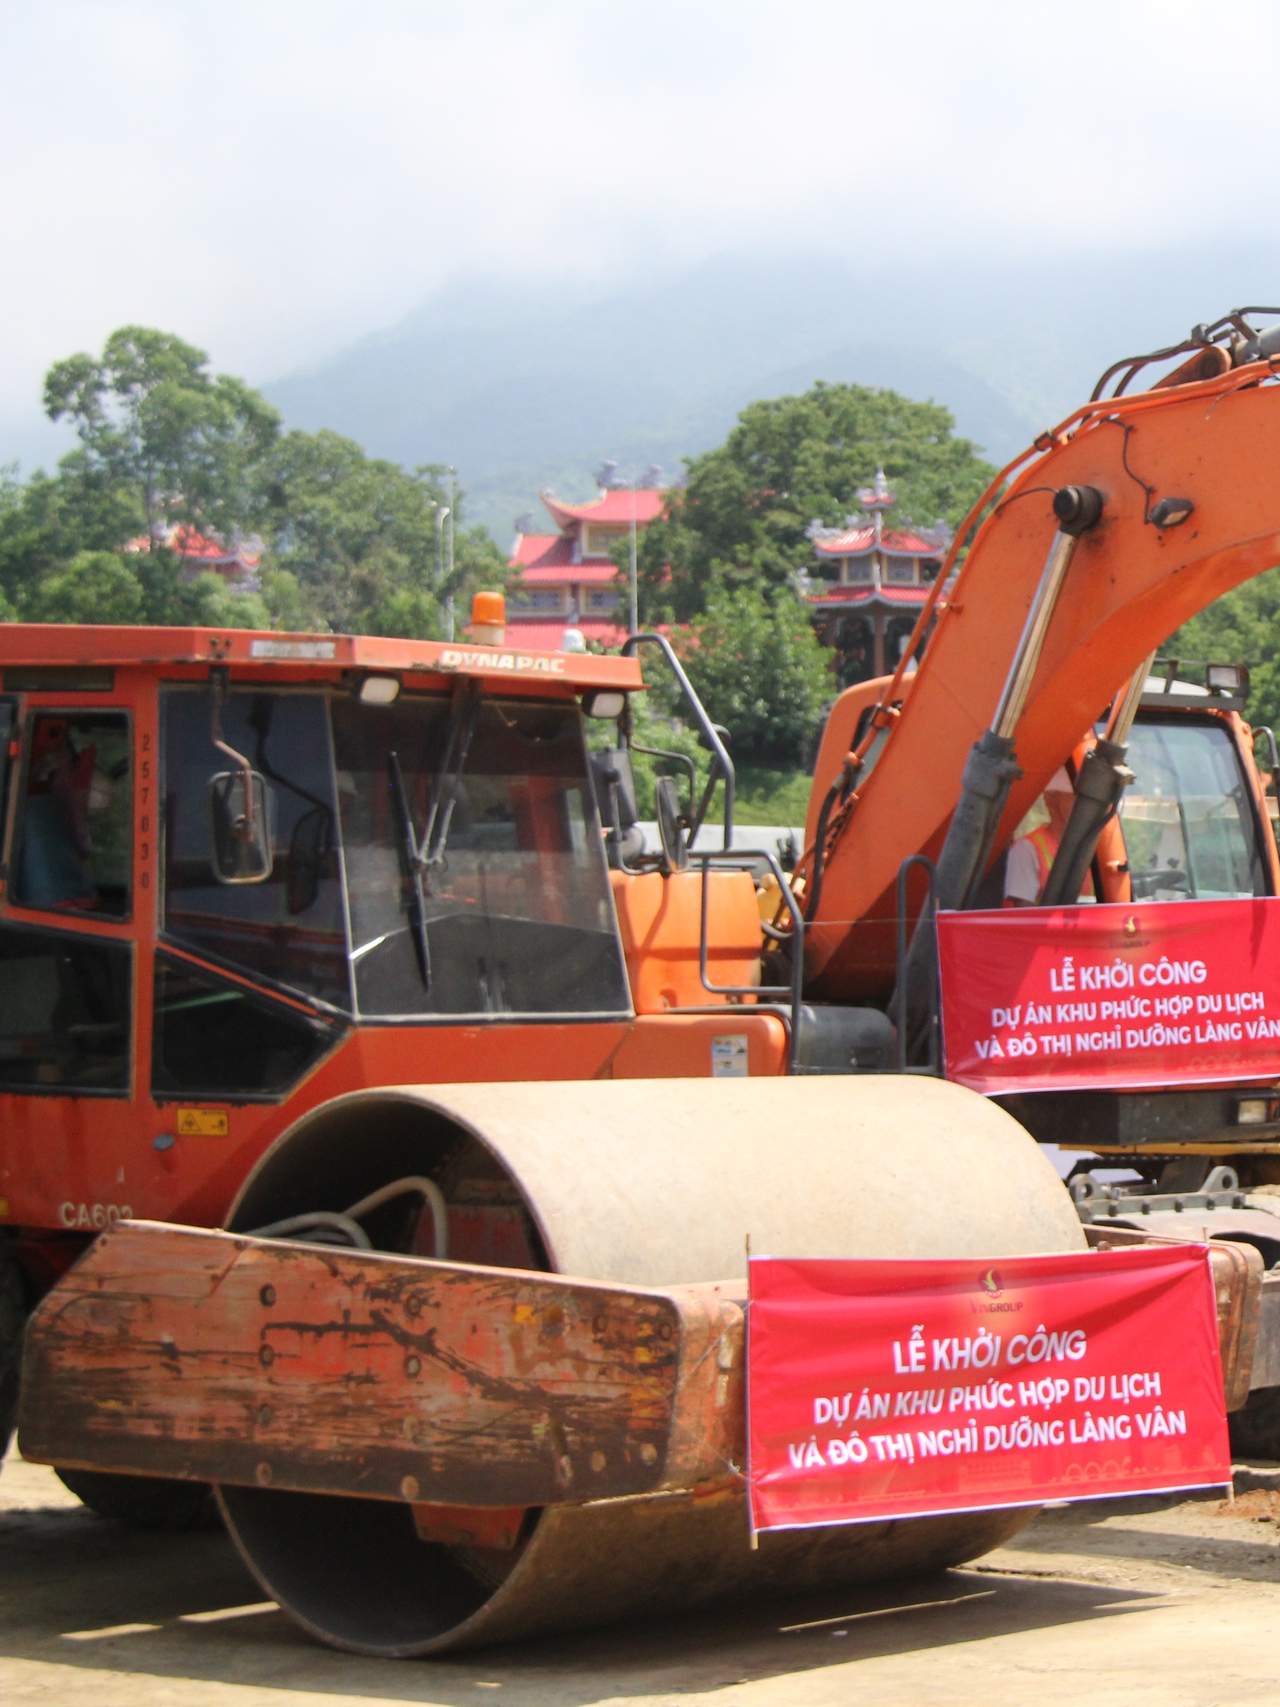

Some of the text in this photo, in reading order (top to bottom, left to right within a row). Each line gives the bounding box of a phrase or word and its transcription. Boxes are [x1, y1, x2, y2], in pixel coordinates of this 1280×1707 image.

[441, 650, 566, 673] DYNAPAC
[1050, 956, 1207, 992] LỄ KHỞI CÔNG
[991, 991, 1265, 1031] DỰ ÁN KHU PHỨC HỢP DU LỊCH
[974, 1034, 1005, 1059] VÀ
[1006, 1031, 1038, 1058] ĐÔ
[1039, 1034, 1072, 1057] THỊ
[1075, 1024, 1122, 1052] NGHỈ
[1125, 1022, 1191, 1049] DƯỠNG
[1194, 1019, 1243, 1044] LÀNG
[970, 1299, 1024, 1314] VINGROUP
[893, 1324, 1087, 1373] LỄ KHỞI CÔNG
[814, 1371, 1162, 1428] DỰ ÁN KHU PHỨC HỢP DU LỊCH
[788, 1404, 1187, 1469] VÀ ĐÔ THỊ NGHỈ DƯỠNG LÀNG VÂN
